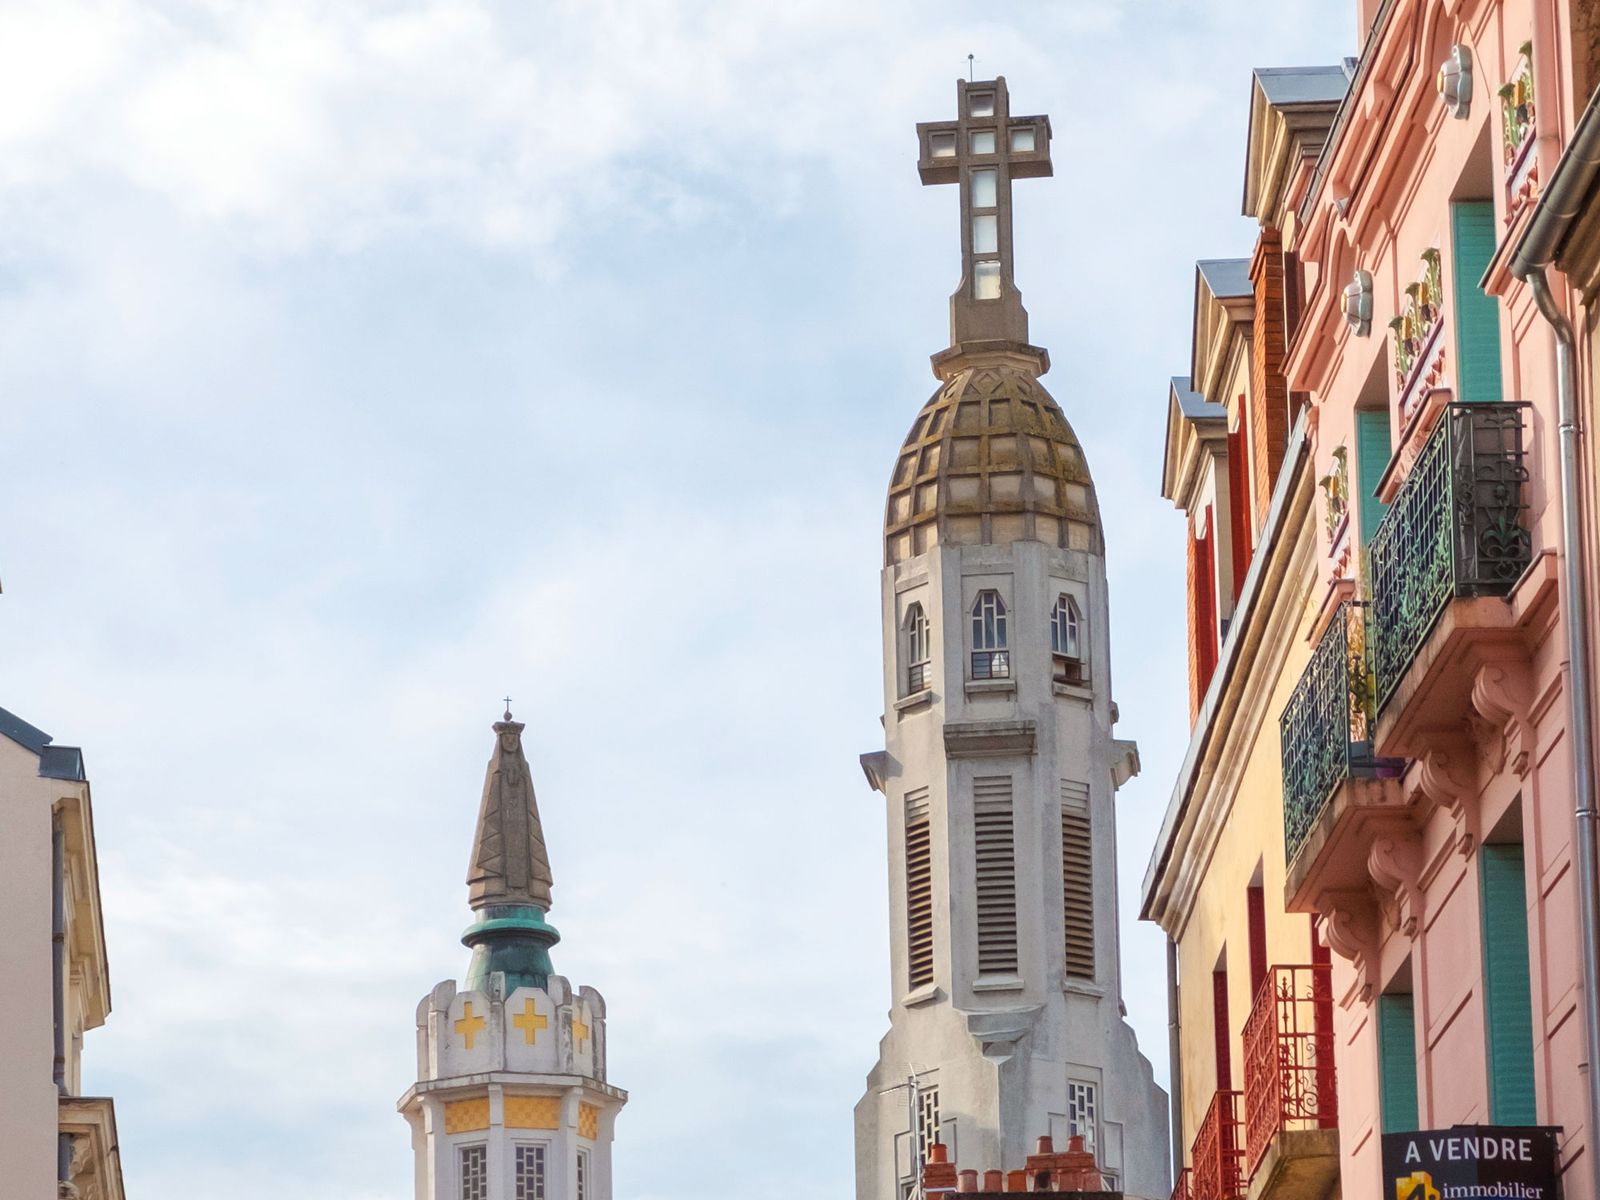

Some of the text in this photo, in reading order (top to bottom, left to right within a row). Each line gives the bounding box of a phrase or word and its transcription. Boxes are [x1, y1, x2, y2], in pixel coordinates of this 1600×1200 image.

[1405, 1137, 1532, 1163] A VENDRE
[1442, 1181, 1543, 1200] immobilier
